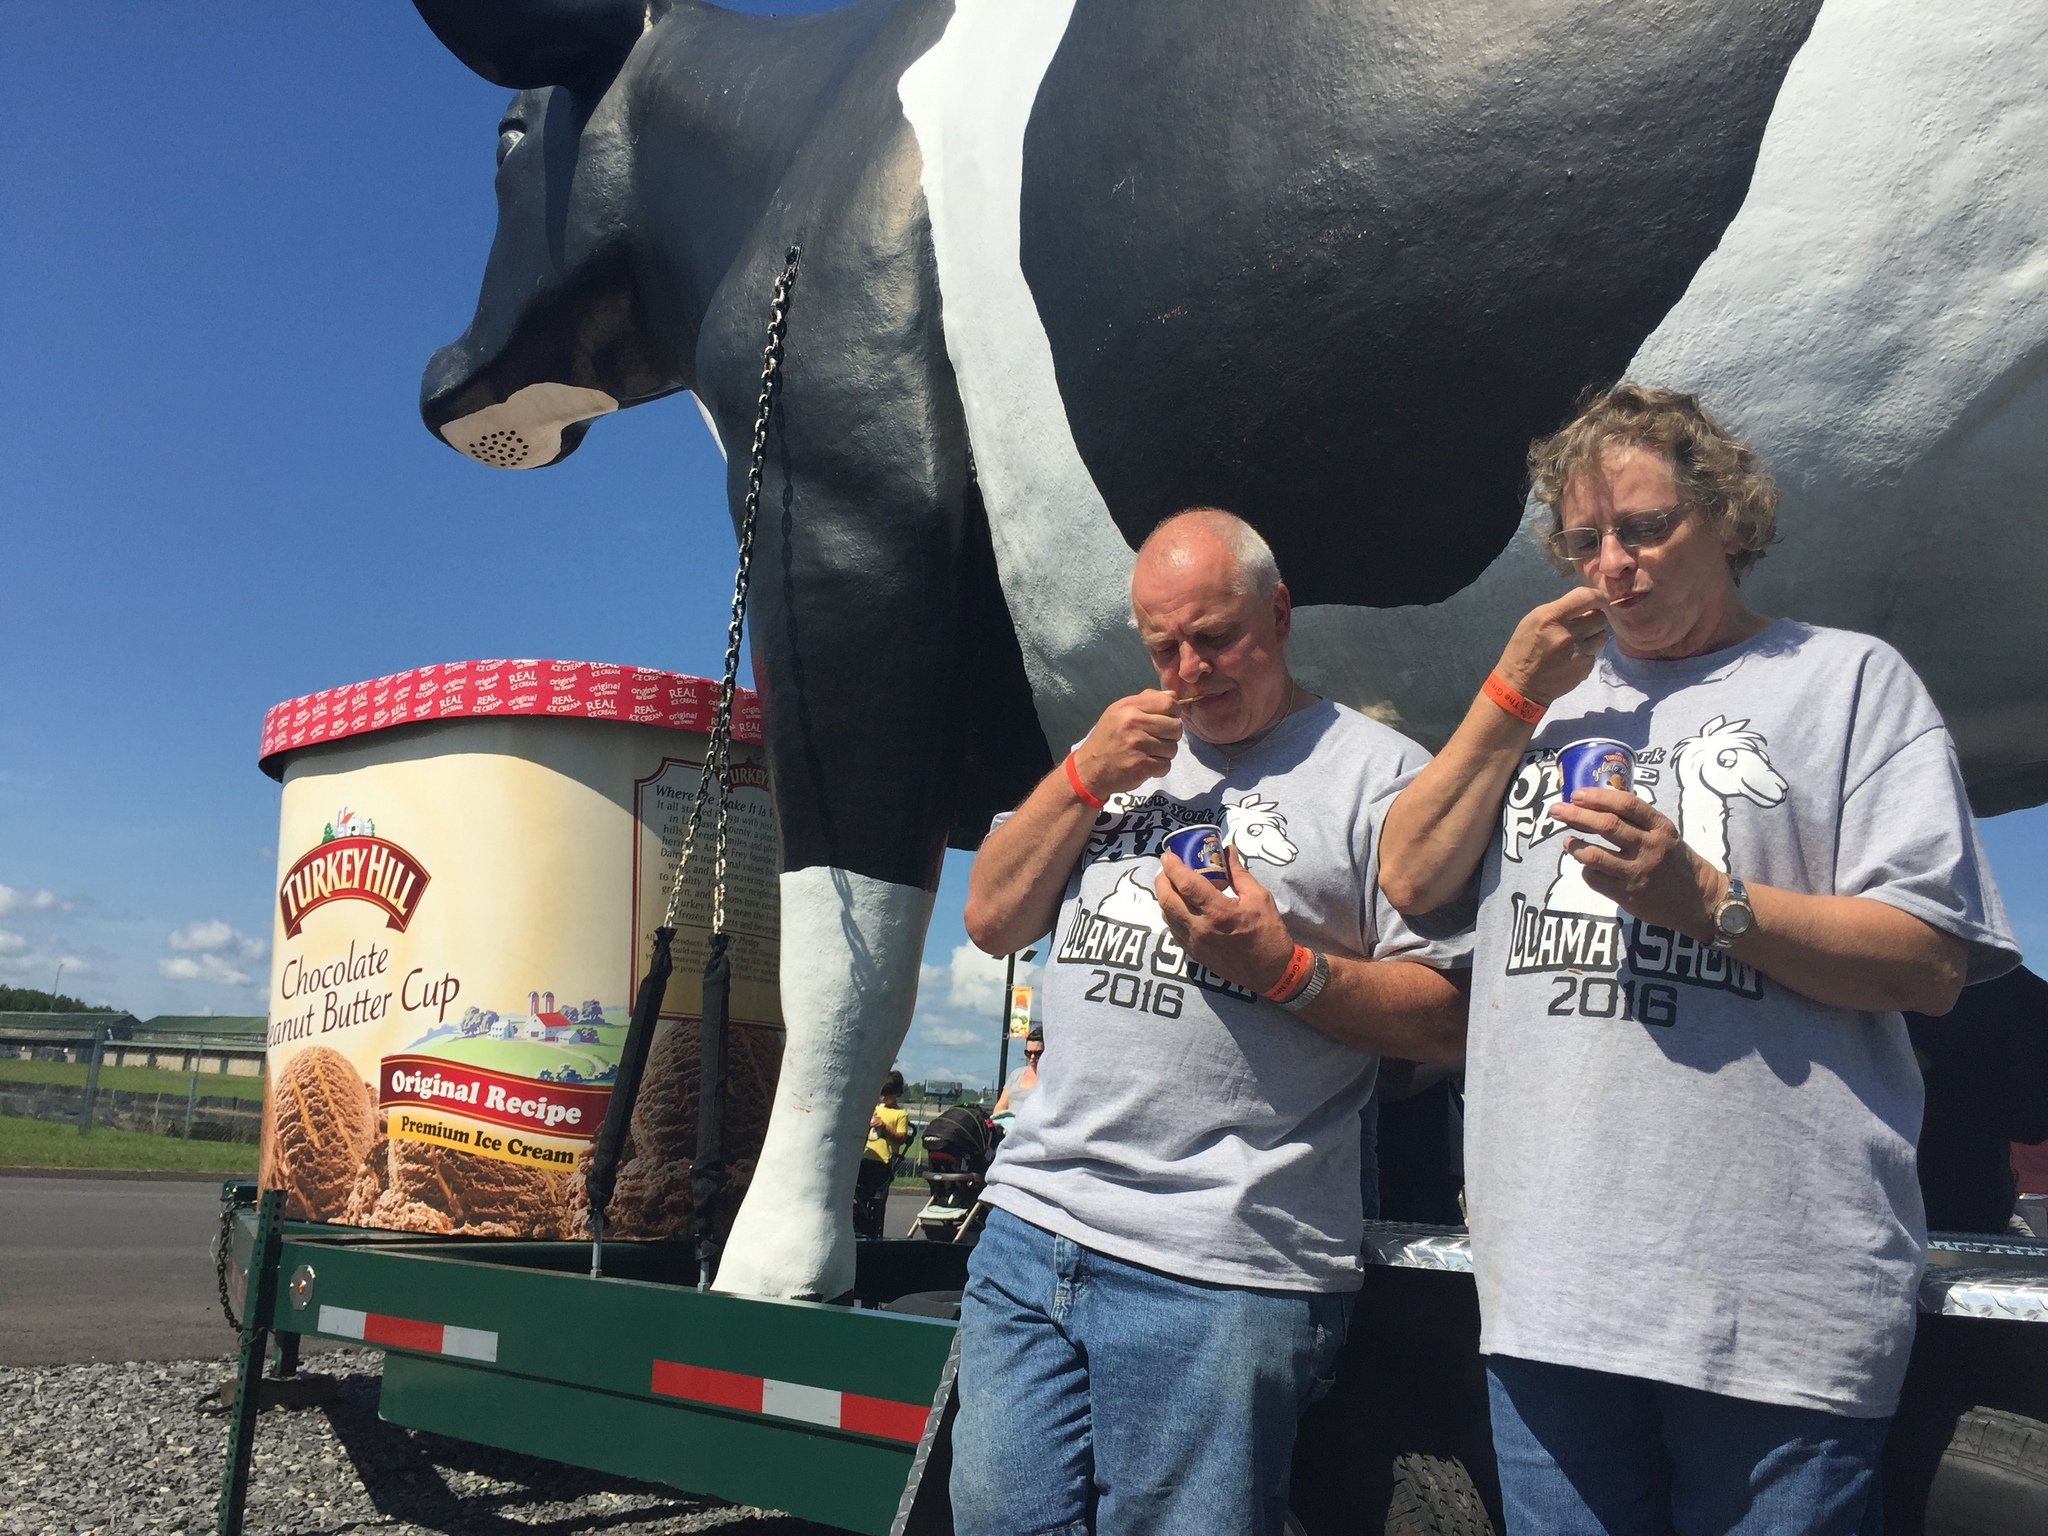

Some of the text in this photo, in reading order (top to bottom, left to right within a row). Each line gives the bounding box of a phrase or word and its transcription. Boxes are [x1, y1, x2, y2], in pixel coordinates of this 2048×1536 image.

[474, 672, 500, 688] original
[508, 670, 536, 684] REAL
[549, 674, 578, 687] original
[589, 682, 620, 693] original
[631, 684, 659, 696] original
[669, 688, 696, 698] REAL
[440, 694, 462, 710] REAL
[476, 694, 498, 706] REAL
[508, 694, 538, 706] original
[552, 694, 576, 705] REAL
[586, 699, 616, 711] REAL
[546, 700, 582, 712] ICE CREAM
[634, 704, 657, 714] REAL
[628, 711, 664, 722] ICE CREAM
[669, 712, 698, 722] original
[739, 723, 760, 732] REAL
[730, 768, 768, 785] URKEY
[656, 785, 694, 802] Where
[749, 803, 756, 814] It
[657, 800, 664, 810] It
[667, 802, 678, 812] all
[1170, 802, 1214, 824] York
[670, 815, 679, 824] in
[731, 848, 748, 860] Frey
[693, 865, 709, 874] and
[283, 844, 419, 920] TURKEY HILL
[660, 873, 669, 882] to
[694, 890, 710, 899] and
[680, 898, 704, 910] urkey
[678, 910, 706, 922] frozen
[1058, 896, 1152, 971] LLAMA
[1506, 892, 1764, 1001] LLAMA SHOW
[282, 939, 389, 1000] Chocolate
[1084, 969, 1185, 1020] 2016
[268, 967, 461, 1048] eanut Butter Cup
[1548, 976, 1678, 1028] 2016
[391, 1070, 582, 1127] Original Recipe
[401, 1115, 574, 1165] Premium Ice Cream
